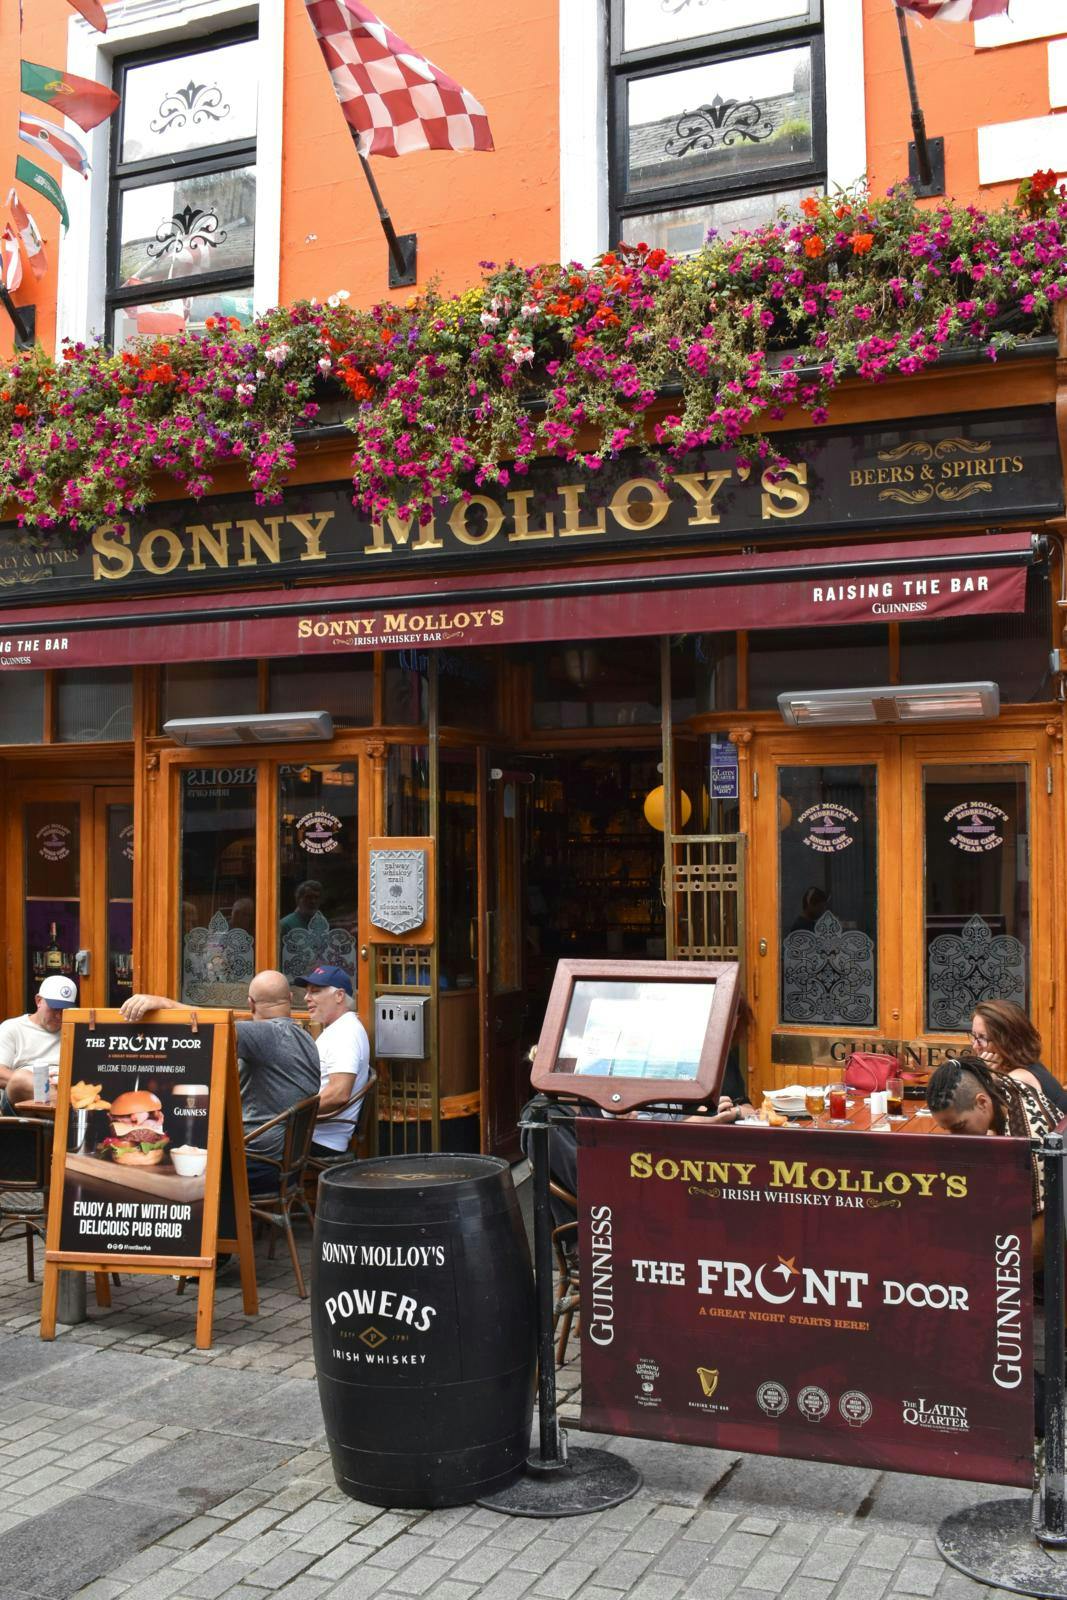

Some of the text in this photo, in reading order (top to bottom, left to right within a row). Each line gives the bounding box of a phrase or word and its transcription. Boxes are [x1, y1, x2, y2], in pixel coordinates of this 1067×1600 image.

[850, 456, 1024, 487] BEERS & SPIRITS
[91, 462, 810, 580] SONNY MOLLOY'S
[0, 549, 79, 570] EY & WINES
[813, 576, 989, 602] RAISING THE BAR
[872, 602, 928, 614] GUINNESS
[298, 609, 504, 639] SONNY MOLLOY'S
[17, 640, 40, 652] THE
[45, 638, 69, 651] BAR
[354, 632, 442, 646] IRISH WHISKEY BAR
[0, 656, 32, 666] GUINNESS
[797, 803, 859, 823] SONNY MOLLOY'S
[944, 801, 1009, 822] SONNY MOLLOY'S
[811, 842, 836, 852] YEAR
[835, 837, 853, 850] OLD
[959, 842, 985, 852] YEAR
[984, 836, 1004, 850] OLD
[85, 1033, 201, 1052] THE FRONT DOOR
[97, 1064, 120, 1073] WELCOME
[127, 1065, 137, 1073] OUR
[137, 1065, 155, 1073] AWARD
[155, 1065, 175, 1073] WINNING
[175, 1065, 186, 1073] BAR
[173, 1106, 207, 1117] GUINNESS
[630, 1152, 968, 1198] SONNY MOLLOY'S
[722, 1188, 865, 1209] IRISH WHISKEY BAR
[73, 1201, 191, 1221] ENJOY A PINT WITH OUR
[79, 1220, 182, 1238] DELICIOUS PUB GRUB
[321, 1241, 446, 1267] SONNY MOLLOY'S
[589, 1205, 615, 1346] GUINNESS
[632, 1255, 970, 1311] THE FRONT DOOR
[324, 1288, 437, 1332] POWERS
[699, 1307, 870, 1331] A GREAT NIGHT STARTS HERE!
[992, 1234, 1023, 1389] GUINNESS
[332, 1348, 426, 1365] IRISH WHISKEY
[902, 1398, 967, 1417] THE LATIN
[903, 1408, 970, 1428] QUARTER
